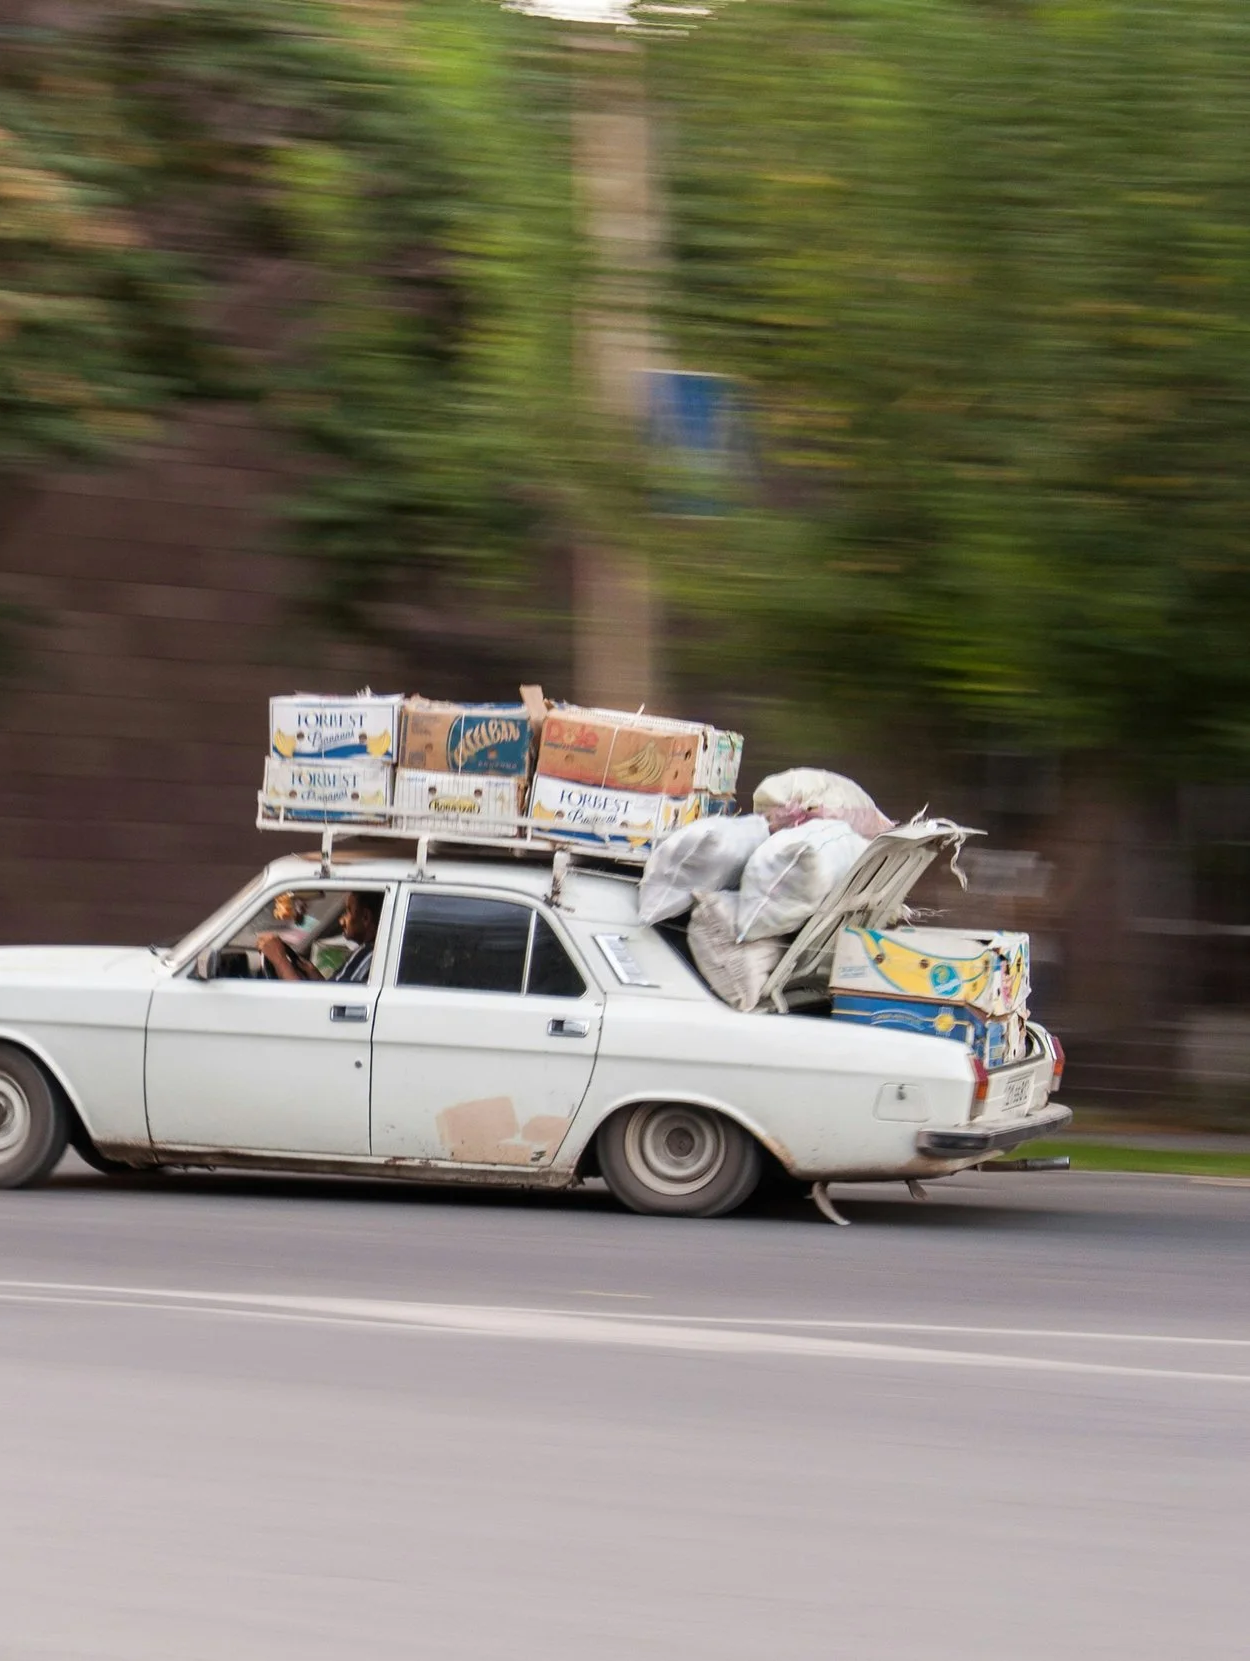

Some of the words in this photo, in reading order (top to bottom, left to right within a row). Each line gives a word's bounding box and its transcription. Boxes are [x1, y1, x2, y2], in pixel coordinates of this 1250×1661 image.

[296, 711, 367, 729] FORBEST
[291, 770, 361, 789] FORBEST
[559, 788, 631, 815] FORBEST
